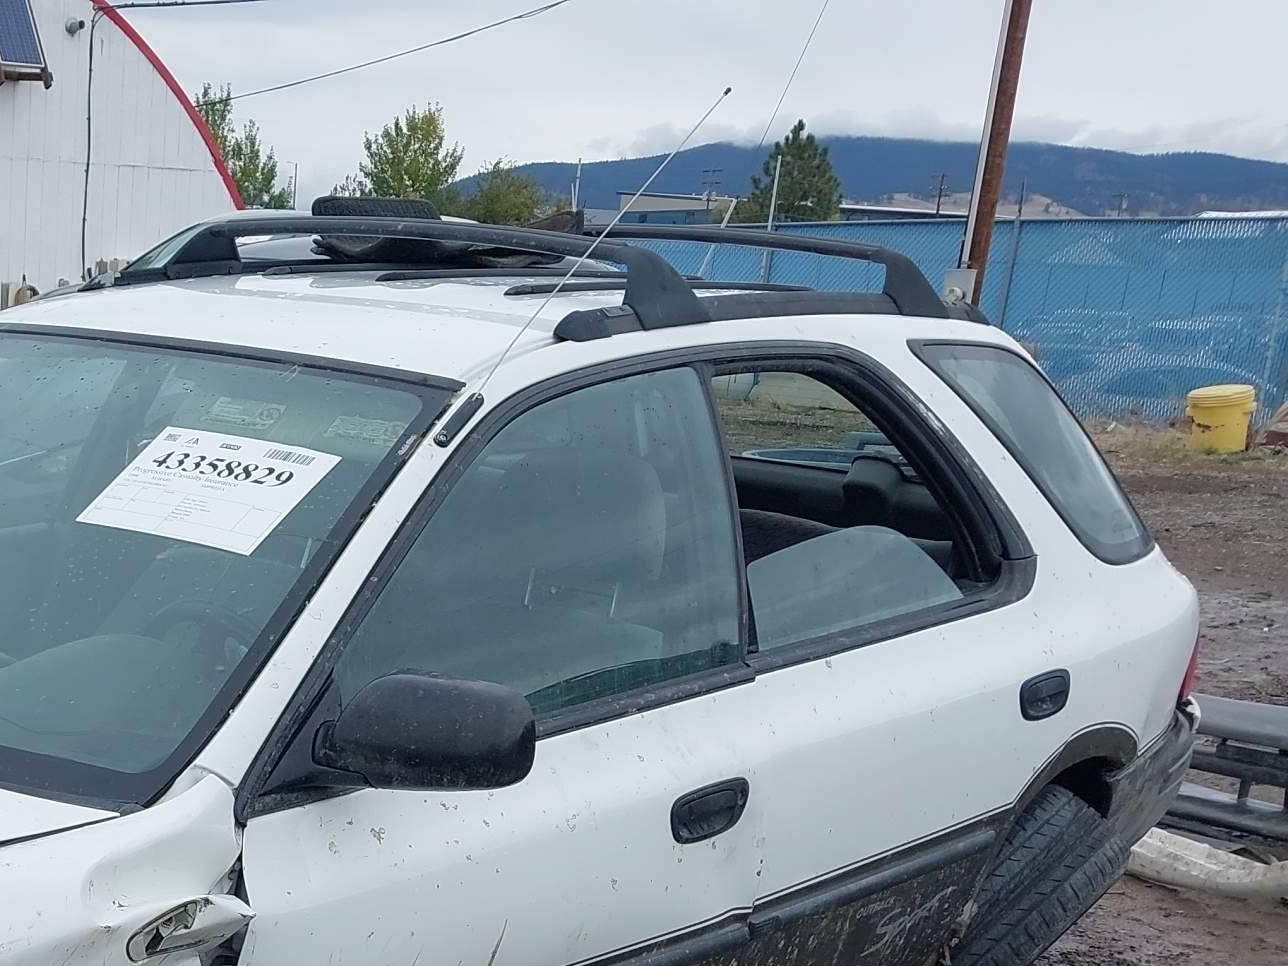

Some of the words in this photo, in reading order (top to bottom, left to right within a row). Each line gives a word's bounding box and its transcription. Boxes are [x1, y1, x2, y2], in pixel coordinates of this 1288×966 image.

[132, 465, 173, 478] Progressive
[173, 470, 202, 482] Casualty
[204, 477, 239, 488] Insurance
[152, 450, 294, 487] 43358829
